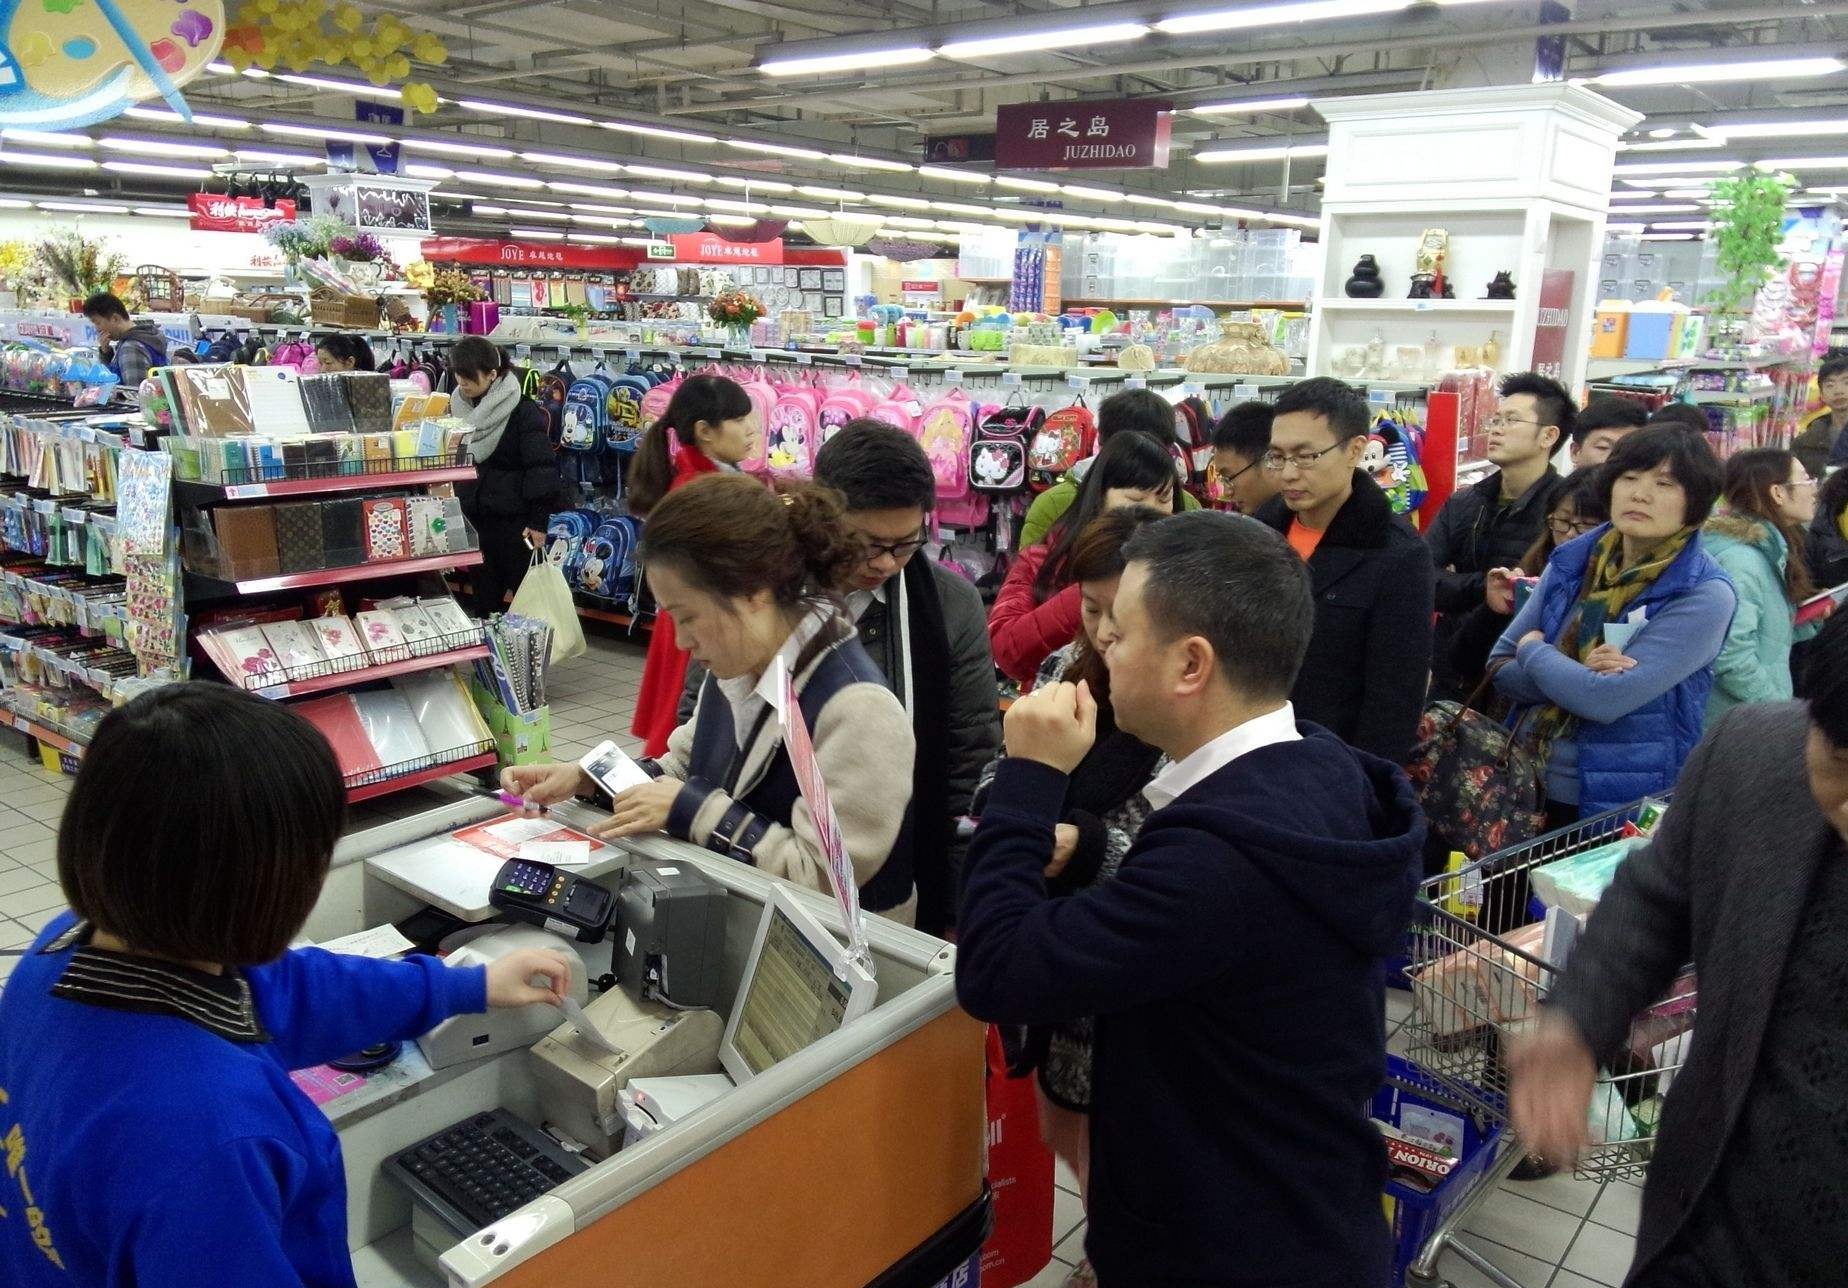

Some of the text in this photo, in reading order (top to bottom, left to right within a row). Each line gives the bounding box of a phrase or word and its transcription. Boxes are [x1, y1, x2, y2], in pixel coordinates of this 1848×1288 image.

[1027, 115, 1110, 139] 居之岛
[1063, 144, 1136, 161] JUZHIDAO
[501, 247, 525, 260] JOYE
[1394, 1150, 1450, 1175] ORION
